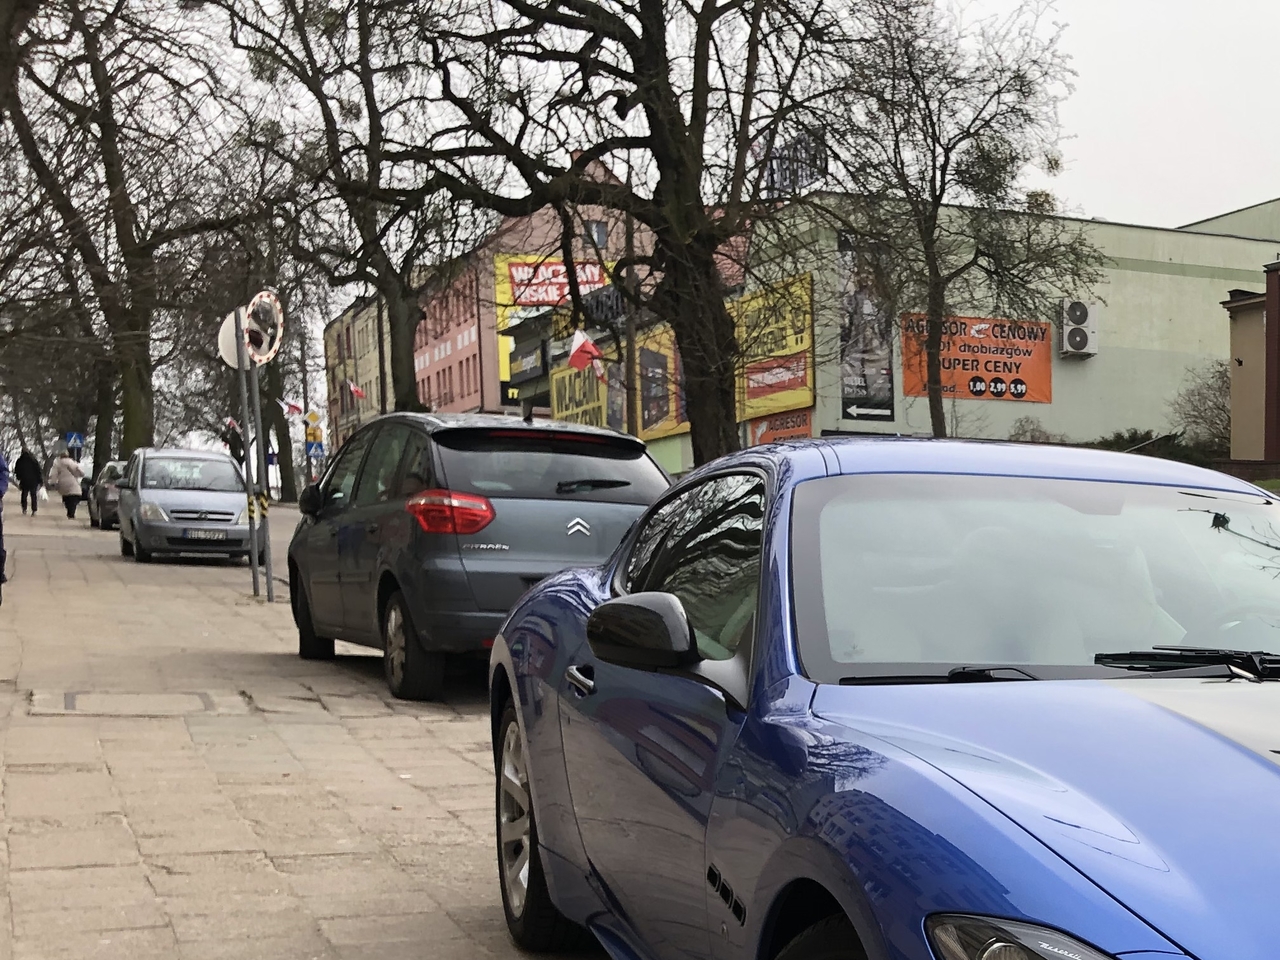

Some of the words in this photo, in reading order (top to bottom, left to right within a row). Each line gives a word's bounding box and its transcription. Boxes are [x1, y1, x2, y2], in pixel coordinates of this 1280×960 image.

[991, 323, 1047, 341] CENOWY
[958, 341, 1033, 359] drobiazgów
[938, 357, 980, 372] UPER
[984, 360, 1022, 375] CENY
[989, 382, 1007, 393] 2,99
[768, 413, 808, 432] AGRESOR
